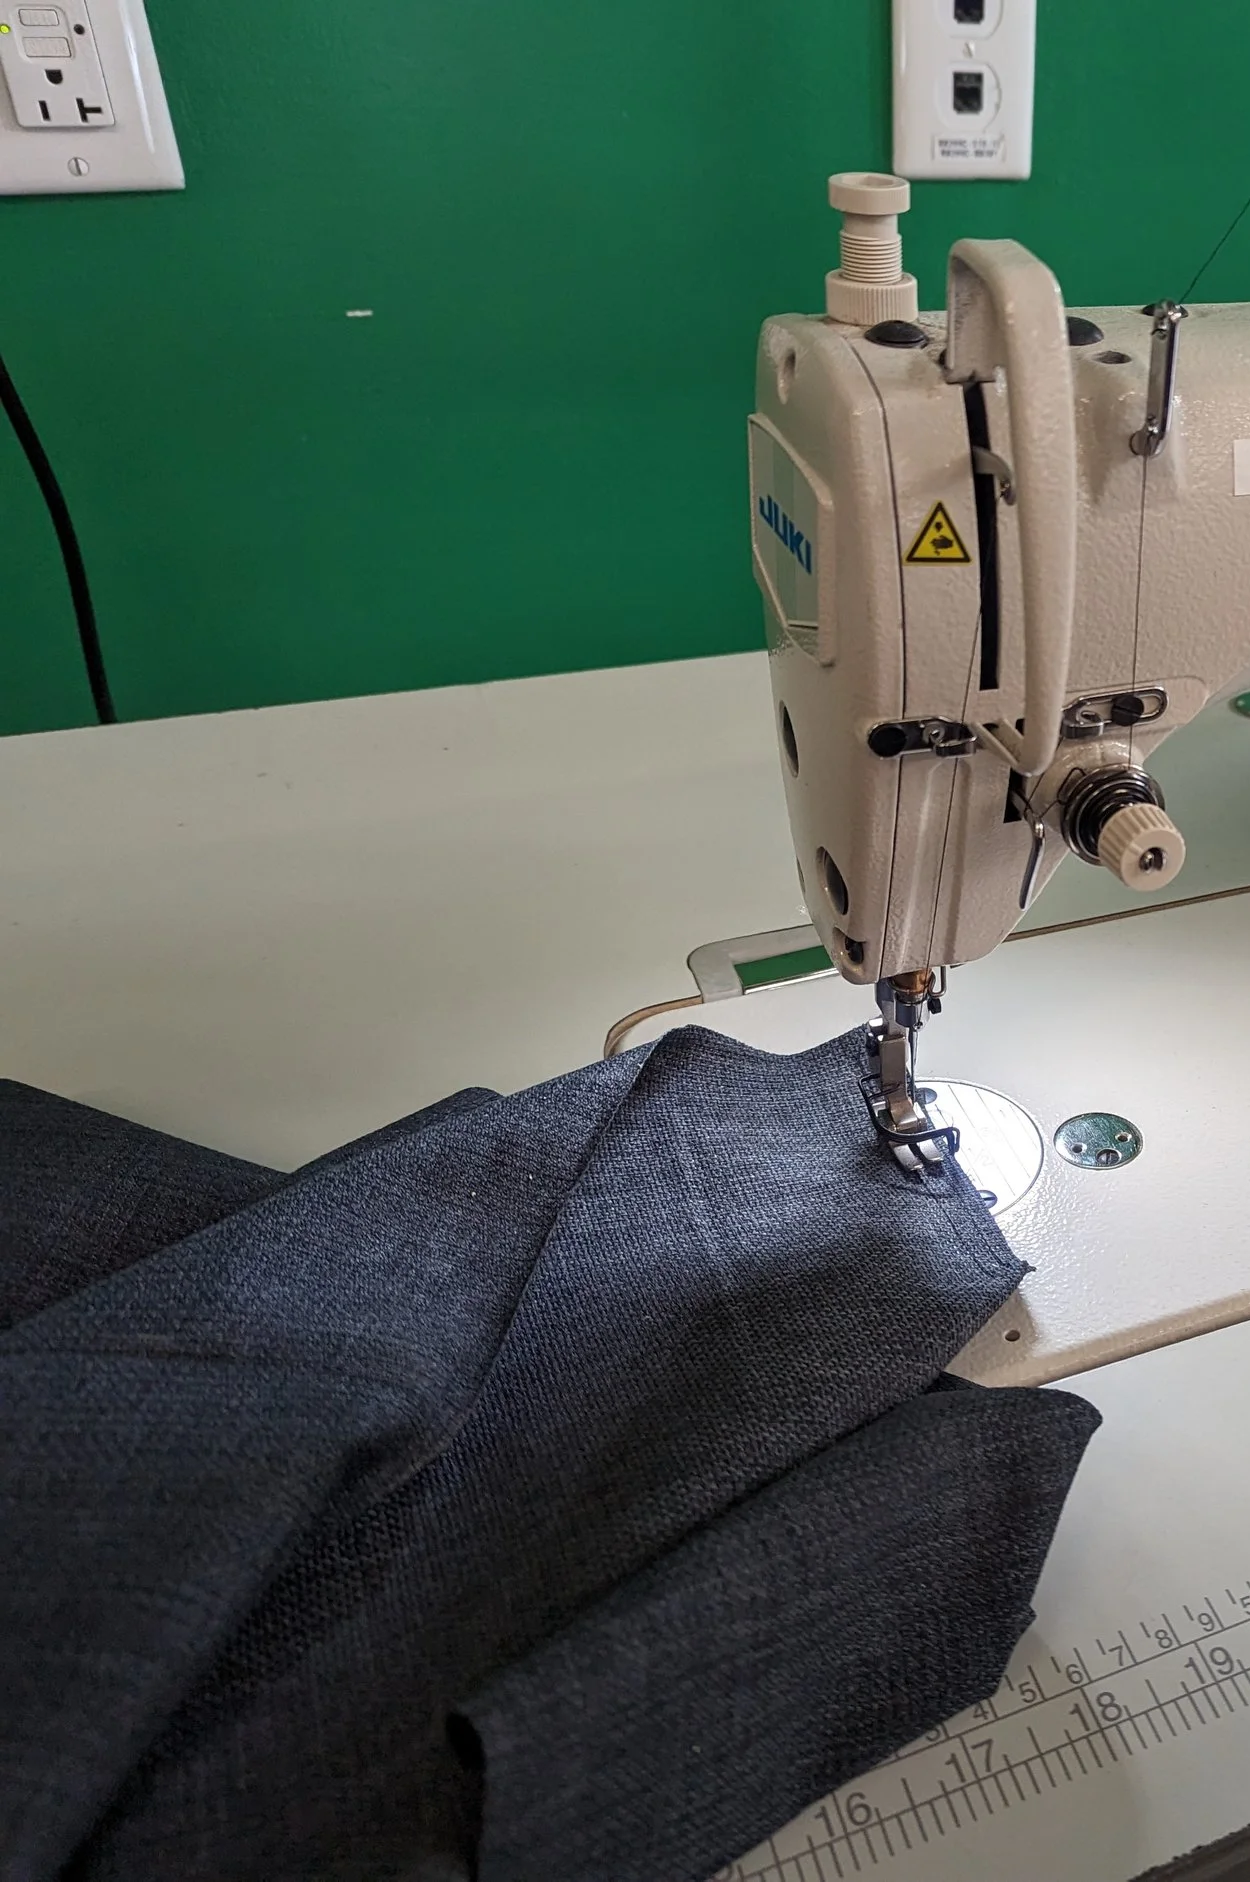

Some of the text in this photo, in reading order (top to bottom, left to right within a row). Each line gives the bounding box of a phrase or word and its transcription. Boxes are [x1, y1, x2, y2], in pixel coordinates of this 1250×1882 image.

[759, 494, 812, 575] JUKI
[972, 1702, 989, 1720] 4
[1018, 1681, 1037, 1704] 5
[1065, 1663, 1083, 1684] 6
[1108, 1645, 1124, 1667] 7
[1154, 1629, 1173, 1649] 8
[1197, 1612, 1215, 1632] 9
[814, 1792, 872, 1837] 16
[945, 1738, 994, 1782] 17
[1069, 1692, 1122, 1731] 18
[1184, 1647, 1235, 1684] 19
